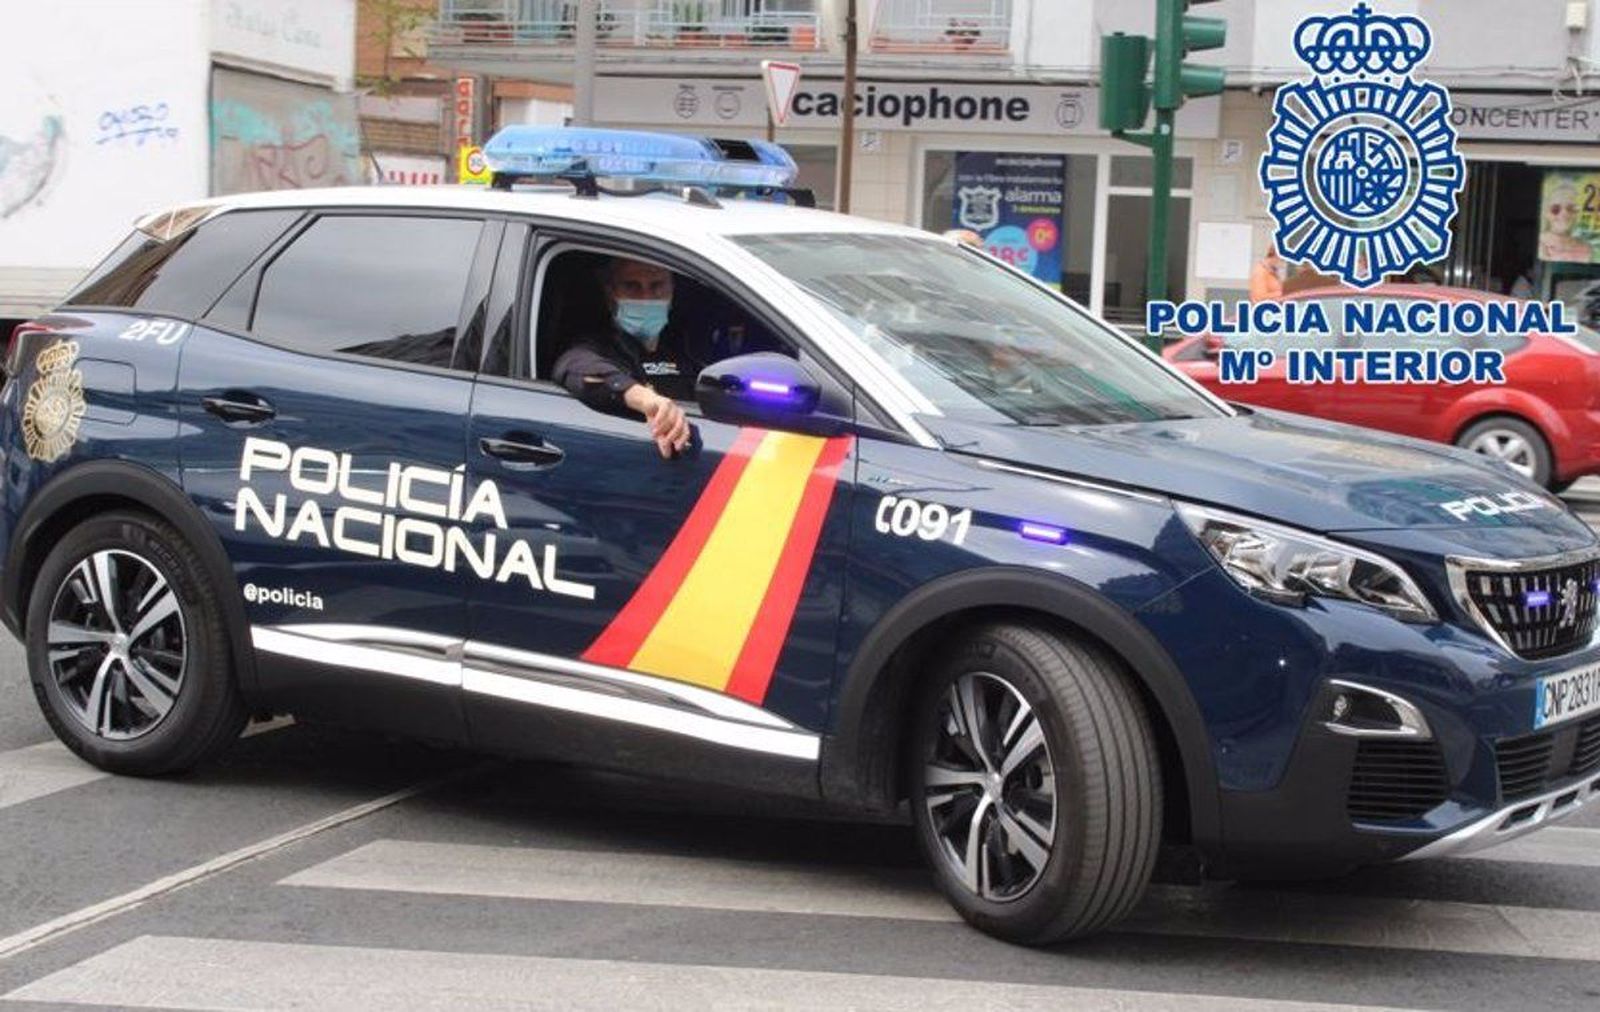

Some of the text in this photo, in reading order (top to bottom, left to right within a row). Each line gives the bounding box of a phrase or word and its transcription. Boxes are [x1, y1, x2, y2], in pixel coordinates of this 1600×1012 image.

[792, 86, 1030, 126] caciophone
[240, 436, 508, 529] POLICÍA
[234, 486, 595, 600] NACIONAL
[243, 583, 324, 611] @policia
